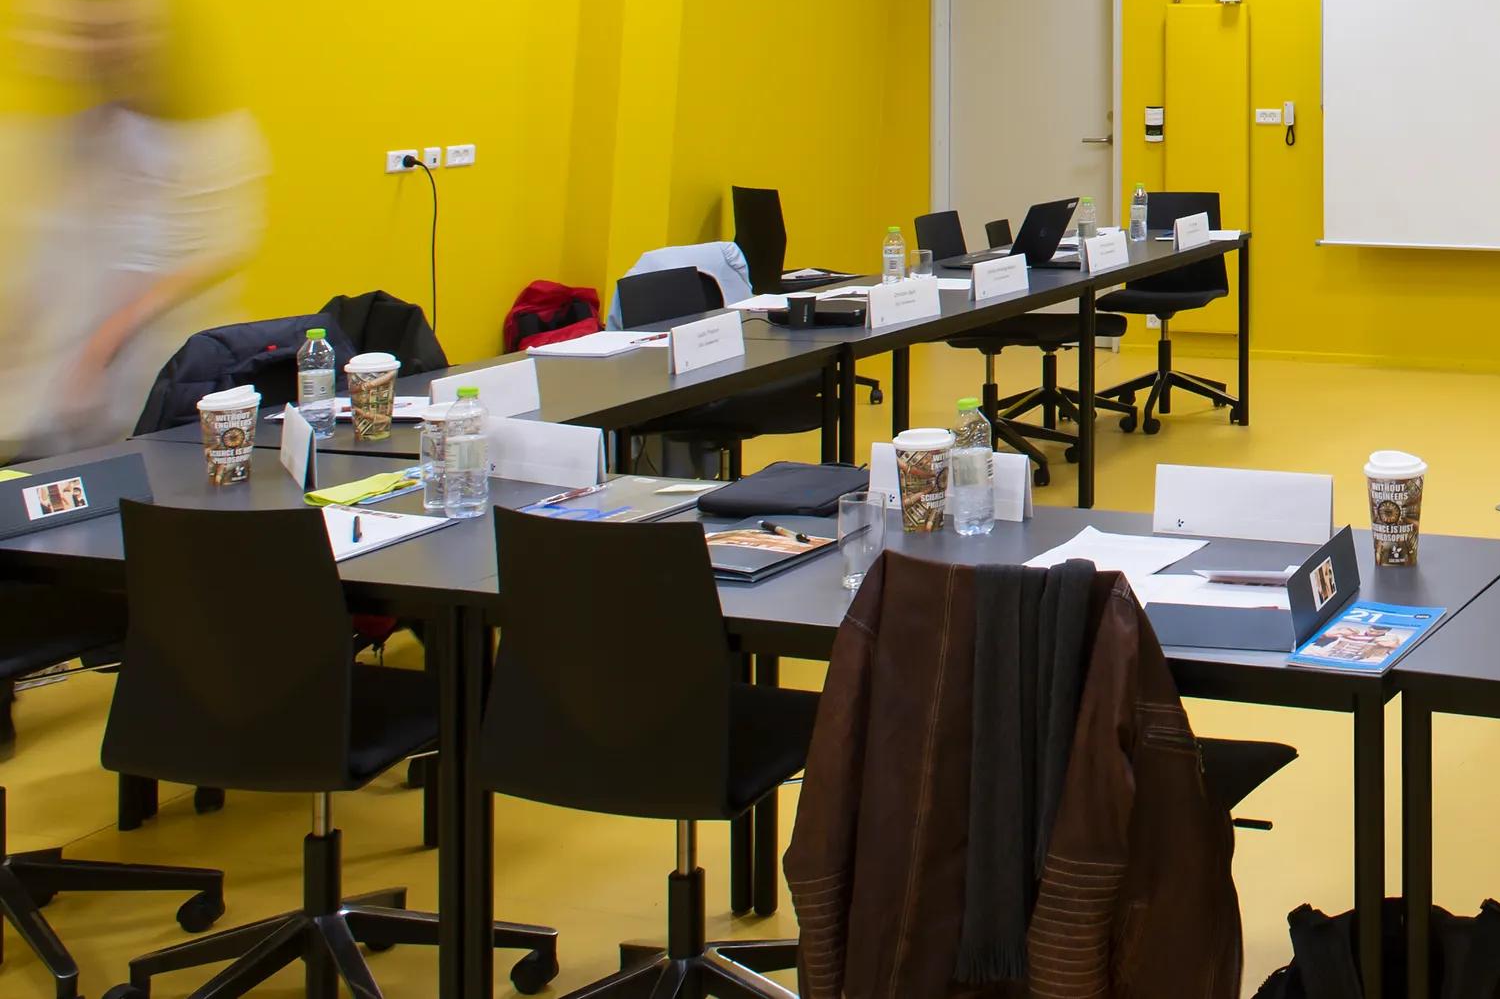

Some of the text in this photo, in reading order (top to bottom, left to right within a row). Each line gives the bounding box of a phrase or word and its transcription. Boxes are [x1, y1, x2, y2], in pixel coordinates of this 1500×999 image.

[1371, 483, 1406, 492] WITHOUT
[1371, 492, 1409, 500] ENGINEERS
[1391, 524, 1399, 534] IS
[1399, 524, 1414, 533] JUST
[1373, 533, 1409, 542] PHILOSOPHY
